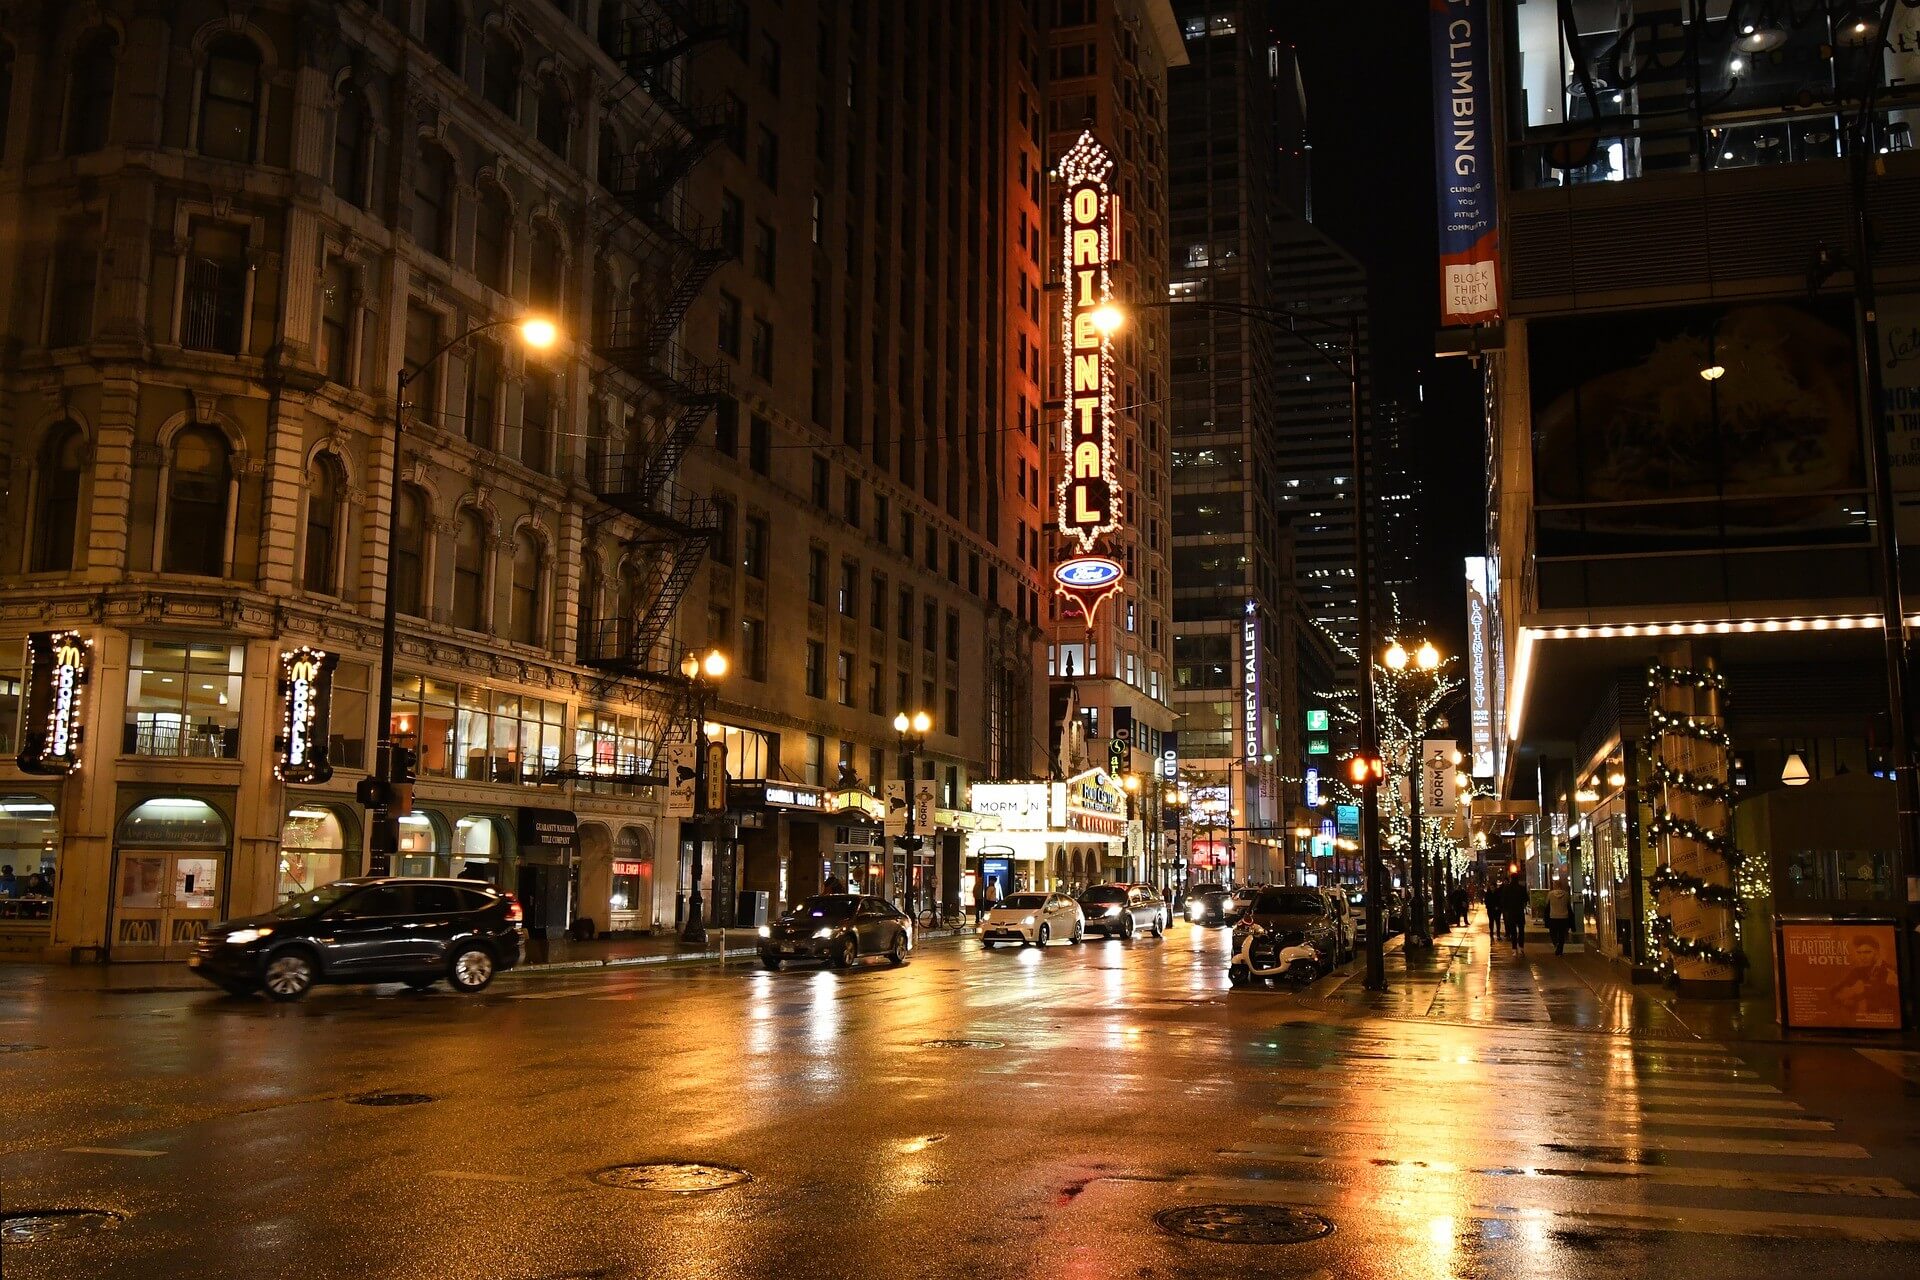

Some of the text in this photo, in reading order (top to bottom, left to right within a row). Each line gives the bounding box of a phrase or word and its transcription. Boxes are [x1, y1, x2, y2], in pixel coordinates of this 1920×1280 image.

[1448, 19, 1477, 176] CLIMBING
[1450, 183, 1481, 193] CLIMBIG
[1454, 209, 1480, 218] FITNES
[1453, 270, 1488, 284] BLOCK
[1454, 282, 1489, 295] THIRTY
[1454, 293, 1489, 306] SEVEN
[1072, 187, 1101, 524] ORIENTAL
[1073, 566, 1104, 581] Ford
[1471, 600, 1485, 708] LATINICITY
[1245, 621, 1257, 766] JOFFREY BALLET
[1164, 750, 1177, 776] OLD
[1433, 749, 1444, 807] MORMON
[920, 786, 928, 827] MORMON
[1789, 939, 1850, 956] HEARTBREAK
[1808, 955, 1850, 966] HOTEL
